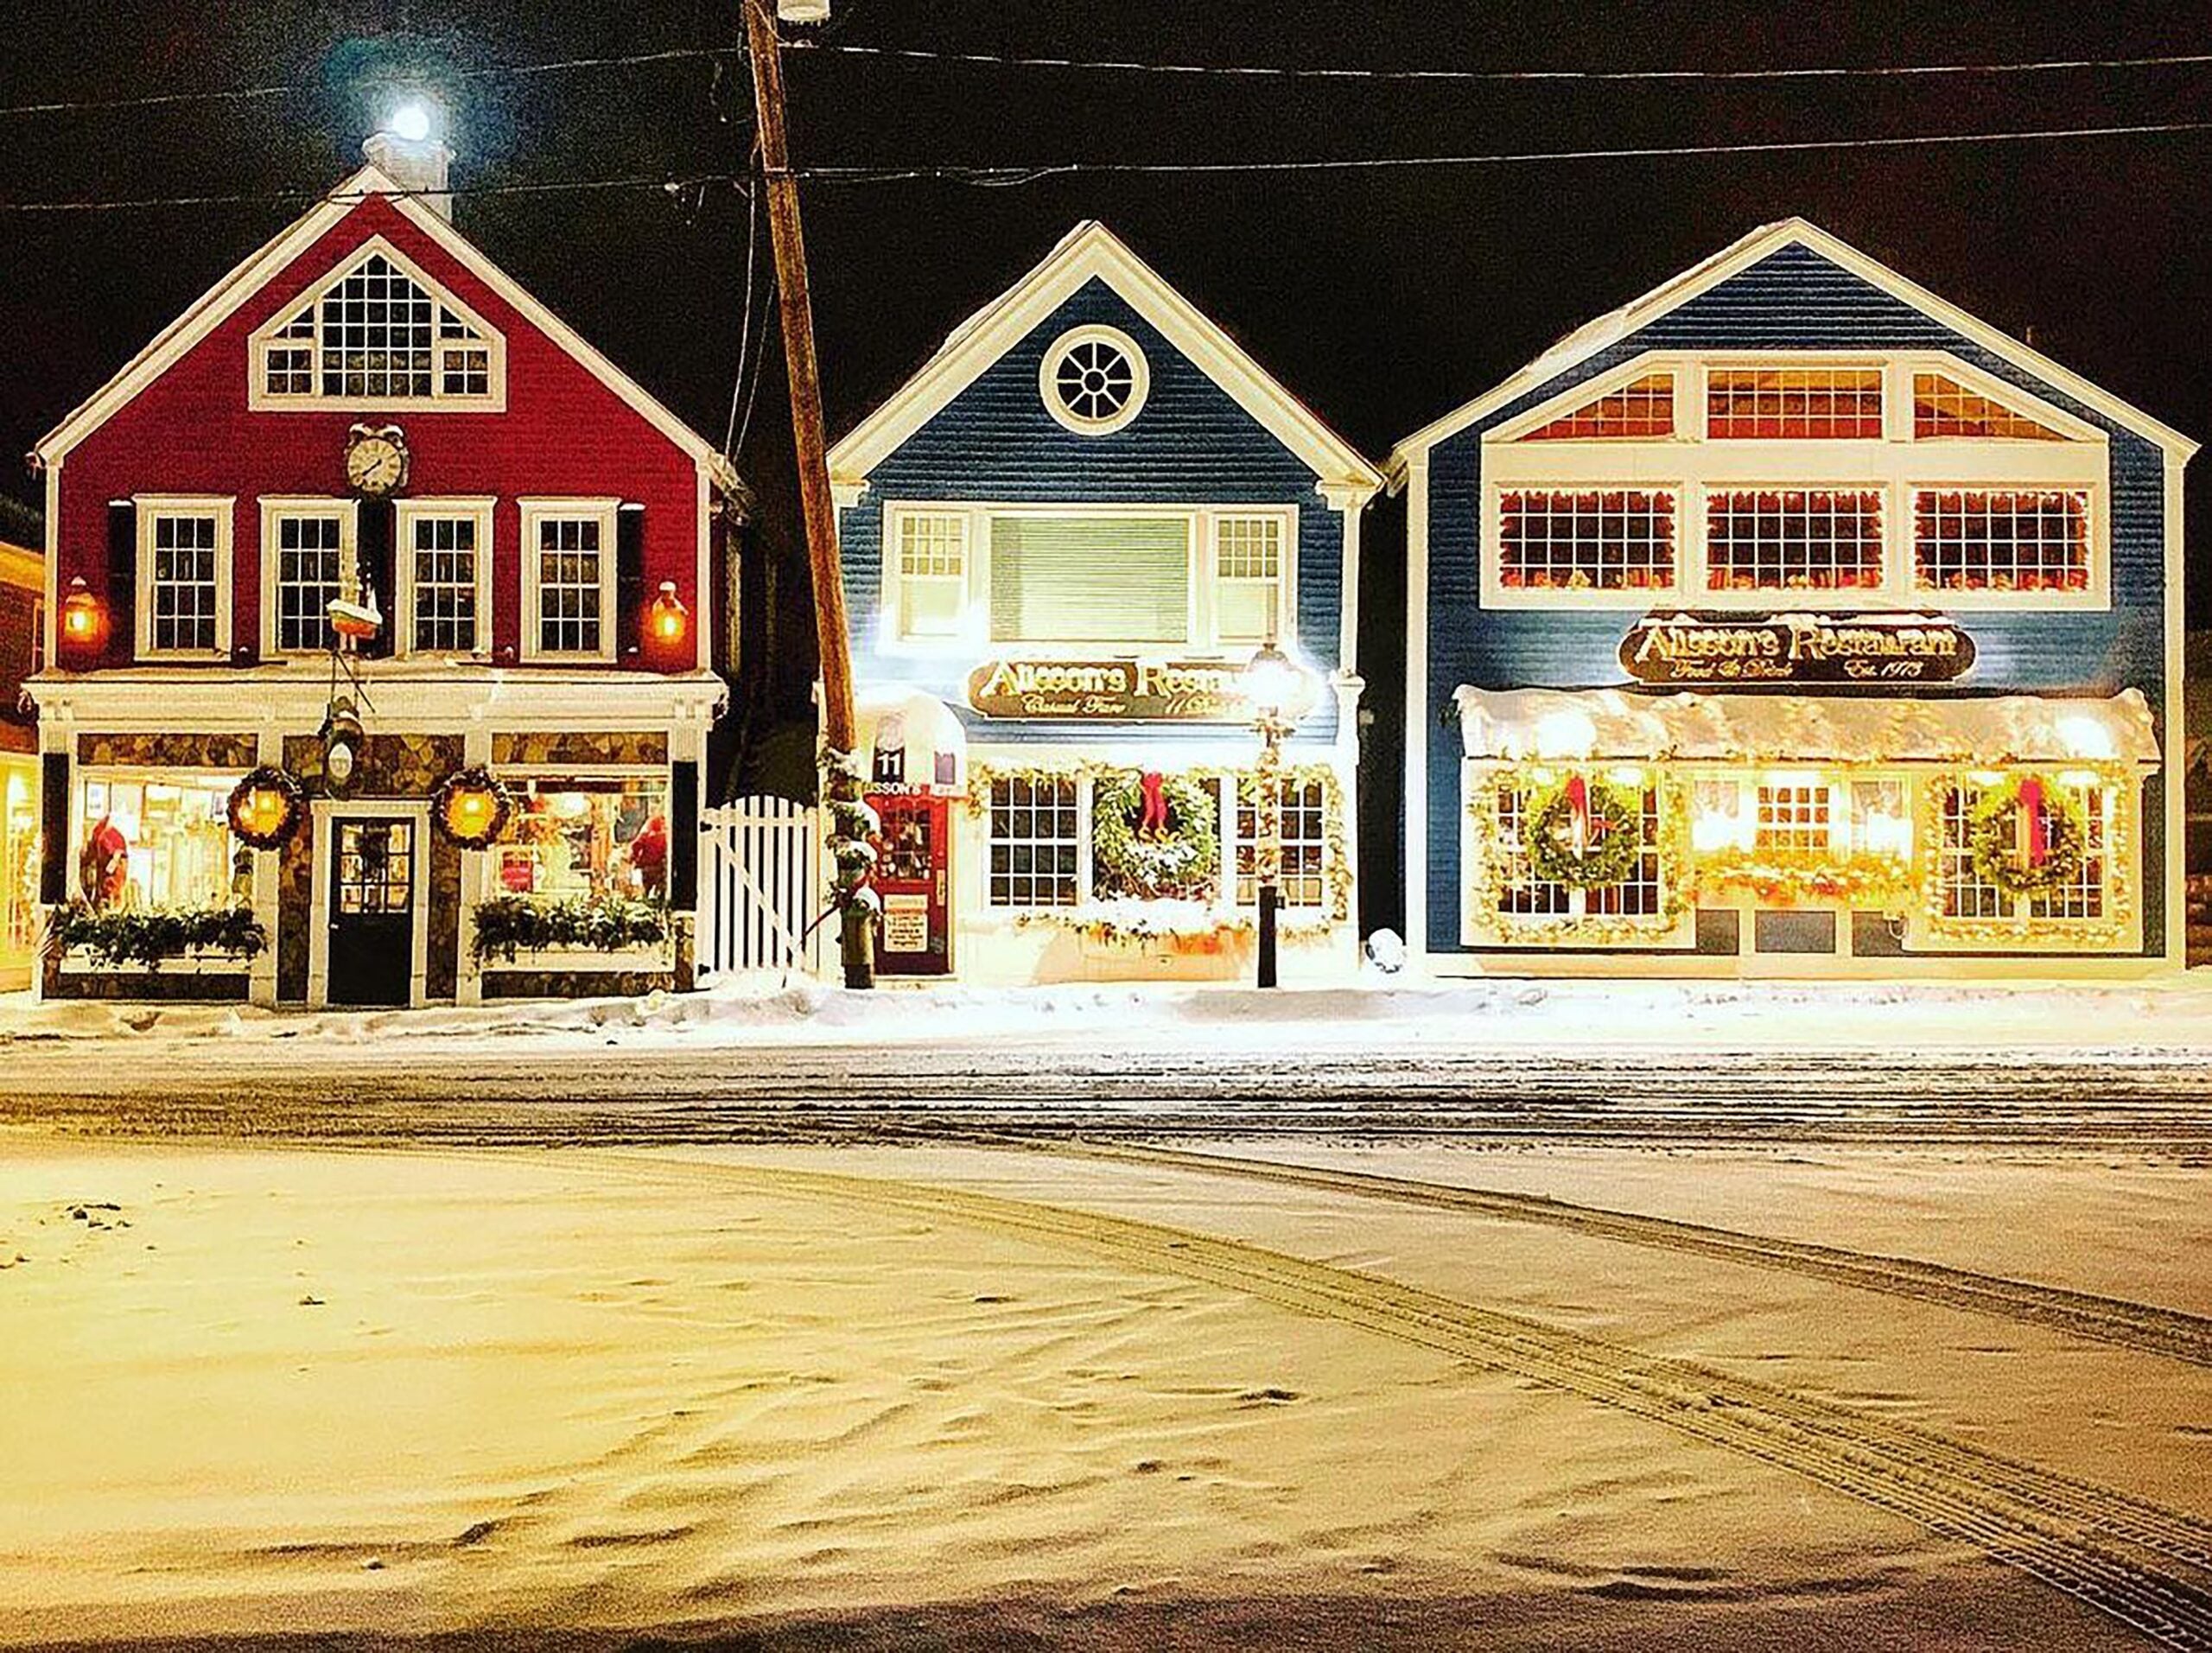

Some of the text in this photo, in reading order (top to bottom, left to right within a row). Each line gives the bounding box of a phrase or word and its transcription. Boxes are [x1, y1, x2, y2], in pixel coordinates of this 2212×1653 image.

[1634, 624, 1957, 664] Alisson's Restaurant
[978, 659, 1127, 697] Alisson's
[877, 753, 900, 776] 11
